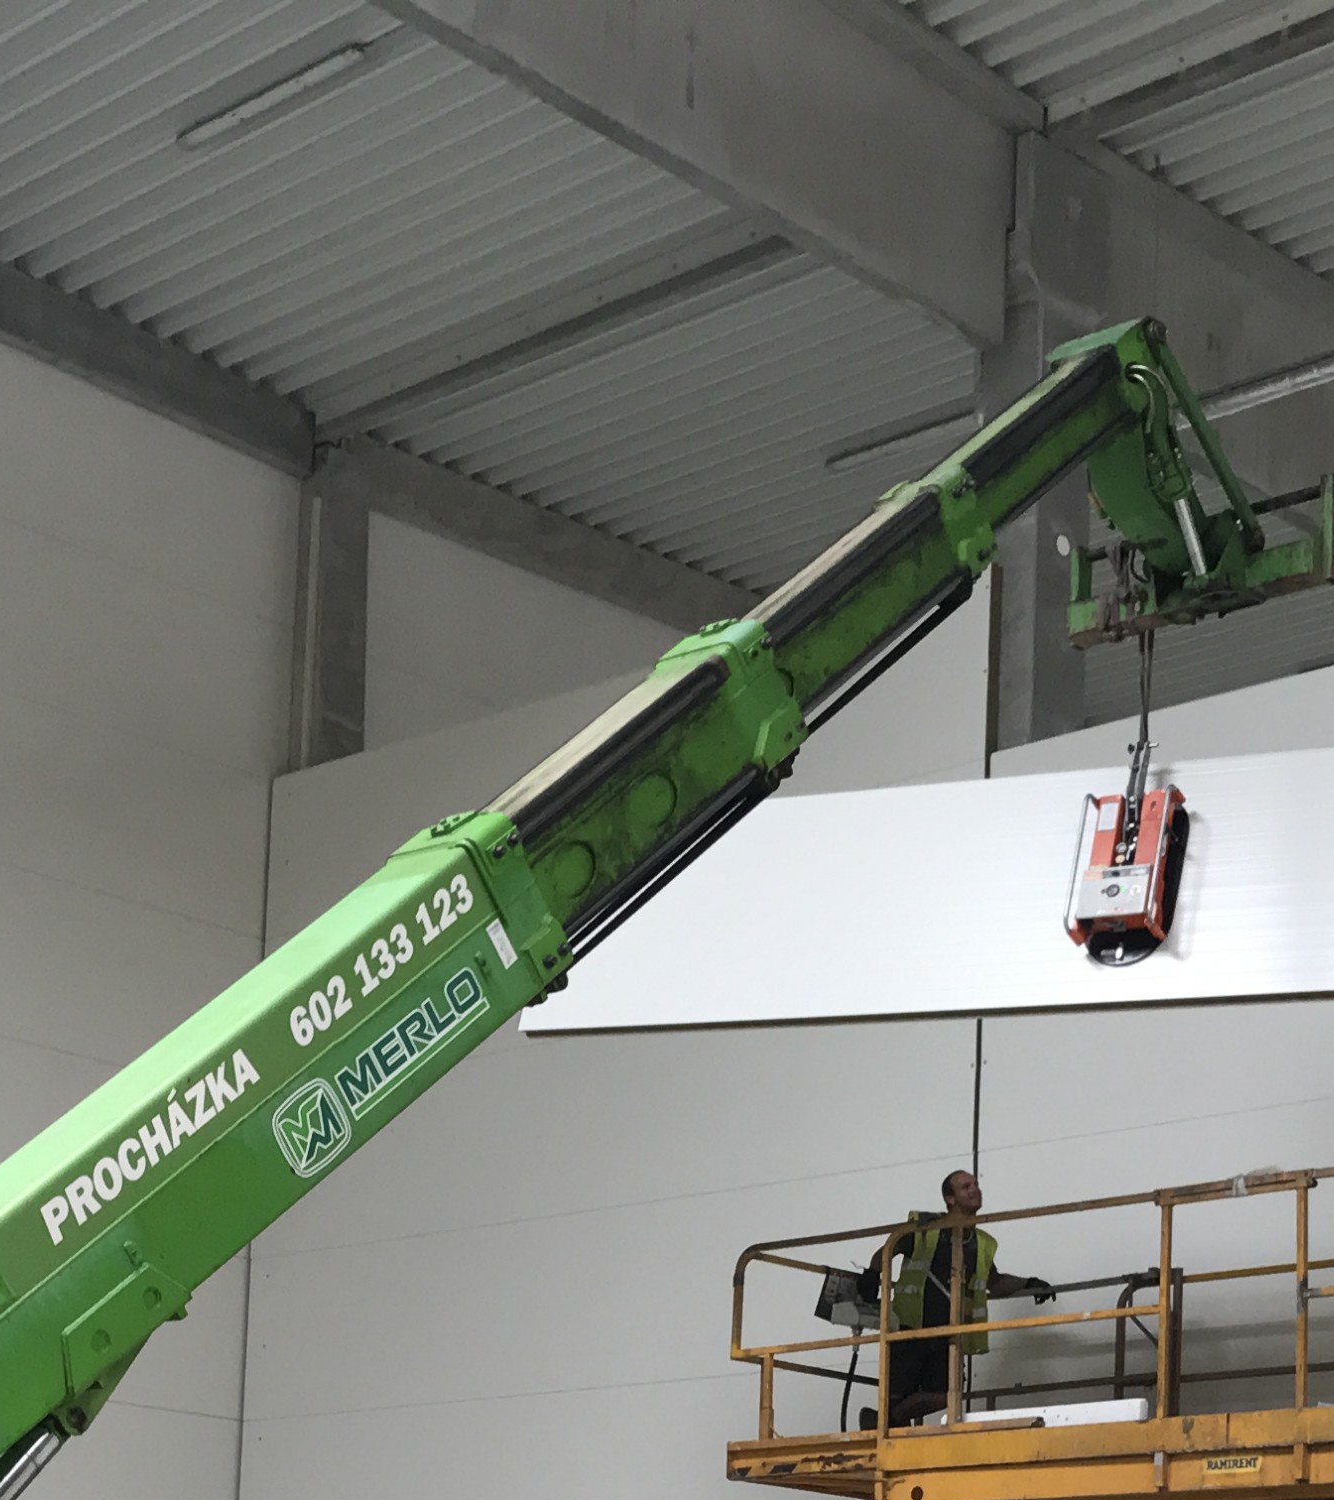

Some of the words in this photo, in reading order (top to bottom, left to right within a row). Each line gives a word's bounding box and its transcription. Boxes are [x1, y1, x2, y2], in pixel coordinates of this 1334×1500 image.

[40, 1048, 261, 1246] PROCHÁZKA
[288, 981, 354, 1047] 602
[353, 924, 415, 998] 133
[415, 873, 475, 946] 123
[335, 967, 484, 1107] MERLO
[1206, 1456, 1259, 1470] RAMIRENT
